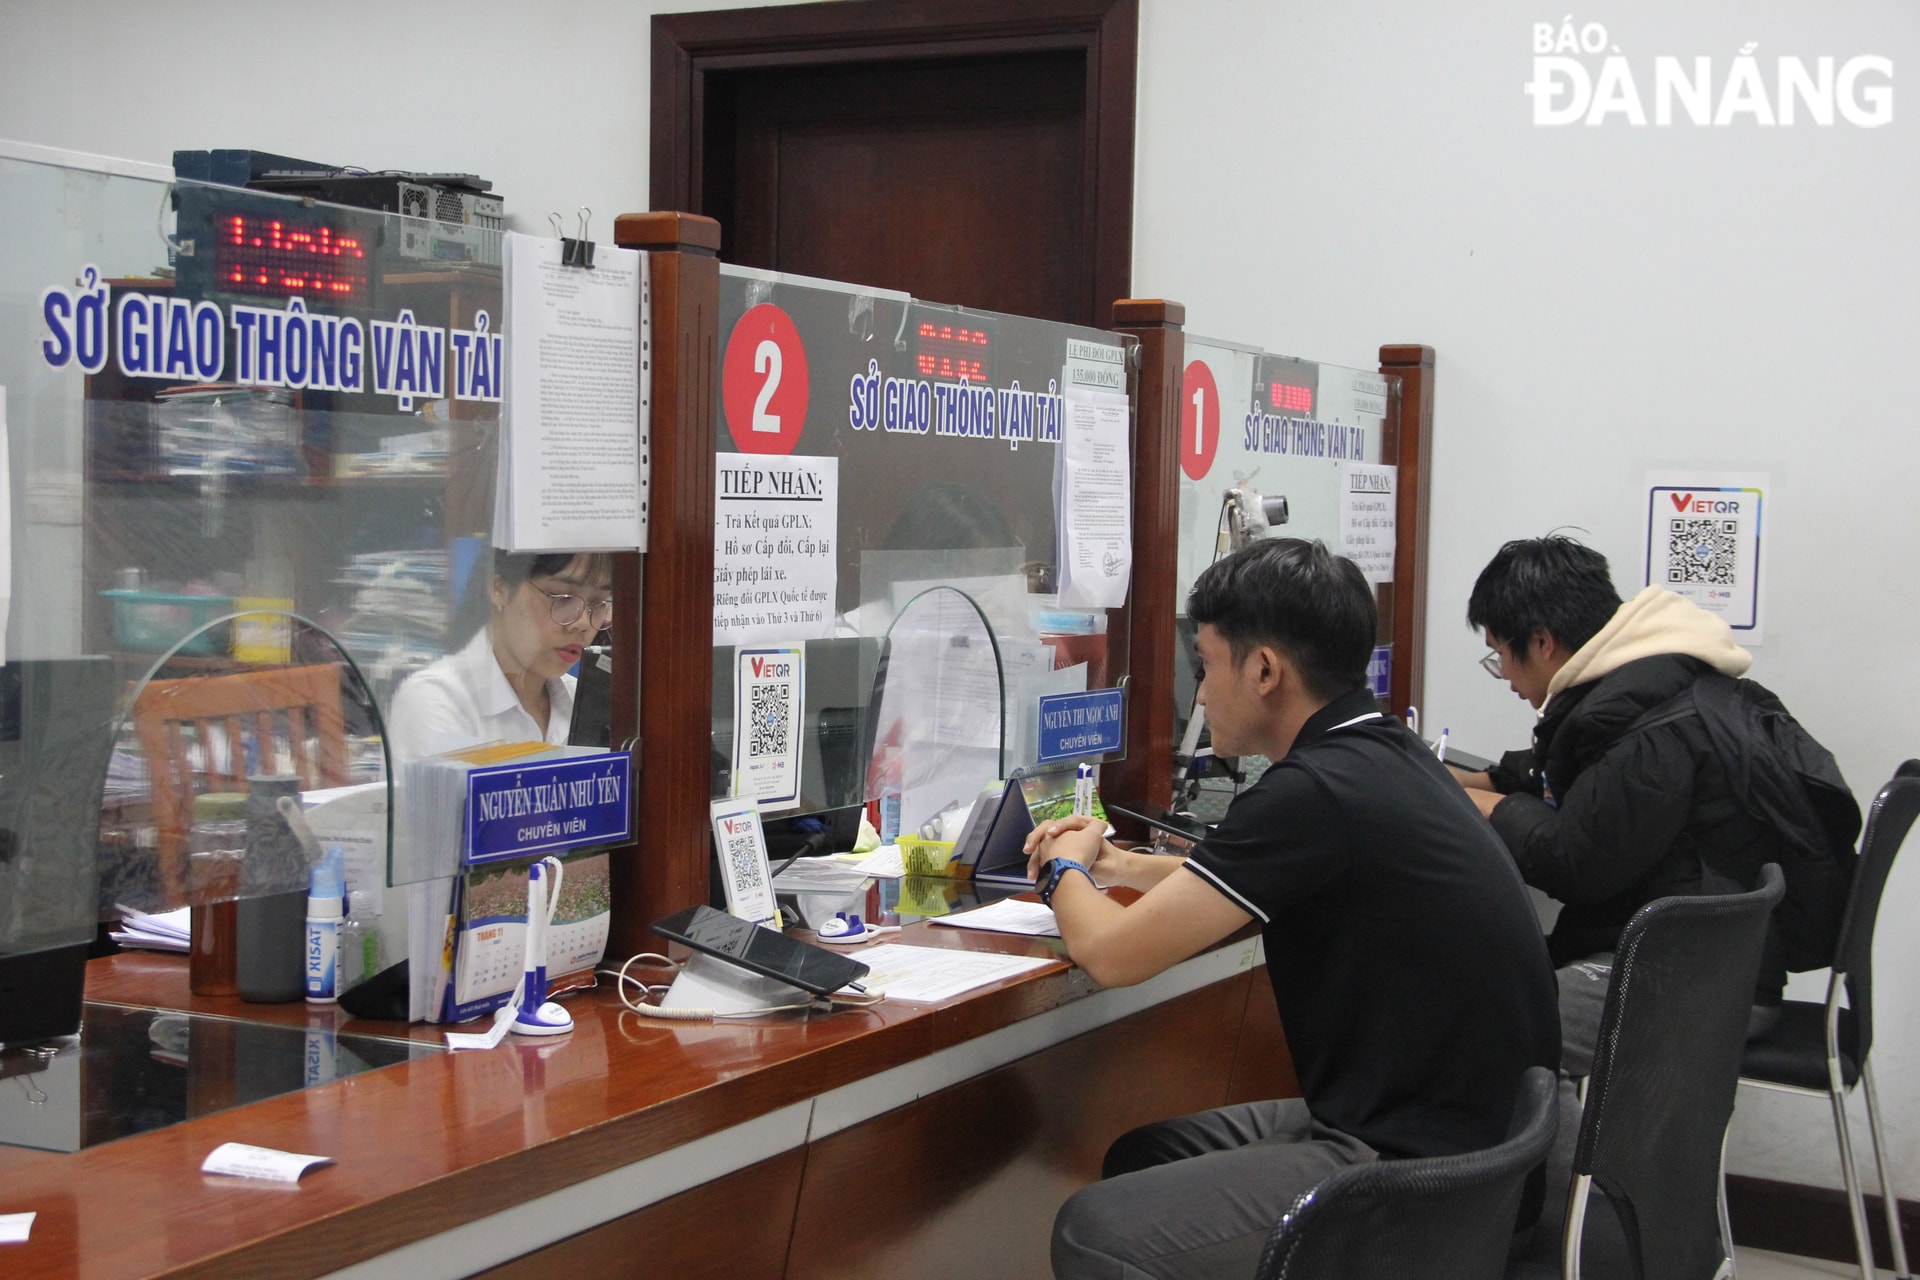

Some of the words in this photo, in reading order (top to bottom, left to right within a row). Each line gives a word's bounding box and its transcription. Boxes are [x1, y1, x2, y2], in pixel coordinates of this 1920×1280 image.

[43, 266, 107, 370] SỞ
[121, 298, 221, 379] GIAO
[235, 301, 362, 389] THÔNG
[373, 313, 442, 407] VẬN
[453, 313, 501, 398] TẢI
[752, 339, 782, 433] 2
[851, 361, 880, 428] SỞ
[885, 381, 930, 432] GIAO
[935, 378, 994, 437] THÔNG
[1000, 382, 1032, 448] VẬN
[1037, 380, 1062, 441] TẢI
[1192, 387, 1204, 455] 1
[1244, 401, 1262, 452] SỞ
[1263, 416, 1288, 454] GIAO
[1291, 412, 1325, 457] THÔNG
[1327, 416, 1347, 467] VẬN
[1350, 415, 1364, 461] TẢI
[720, 462, 764, 494] TIẾP
[768, 468, 822, 498] NHẬN:
[1670, 492, 1740, 514] VIETQR
[744, 510, 760, 529] Kết
[725, 536, 739, 555] Hồ
[741, 543, 752, 555] sơ
[755, 535, 774, 558] Cấp
[797, 535, 816, 557] Cấp
[818, 539, 830, 557] lại
[736, 566, 758, 586] phép
[760, 566, 772, 581] lái
[754, 590, 779, 604] GPLX
[780, 586, 799, 605] Quốc
[731, 613, 751, 629] nhận
[750, 656, 791, 679] VIETQR
[1060, 733, 1087, 751] CHUYÊN
[1087, 731, 1103, 747] VIÊN
[479, 773, 532, 822] NGUYỄN
[534, 775, 568, 815] XUÂN
[569, 772, 597, 809] NHƯ
[597, 763, 621, 805] YẾN
[517, 821, 561, 842] CHUYÊN
[563, 817, 587, 835] VIÊN
[724, 818, 753, 835] VIETQR
[308, 927, 322, 972] XISAT
